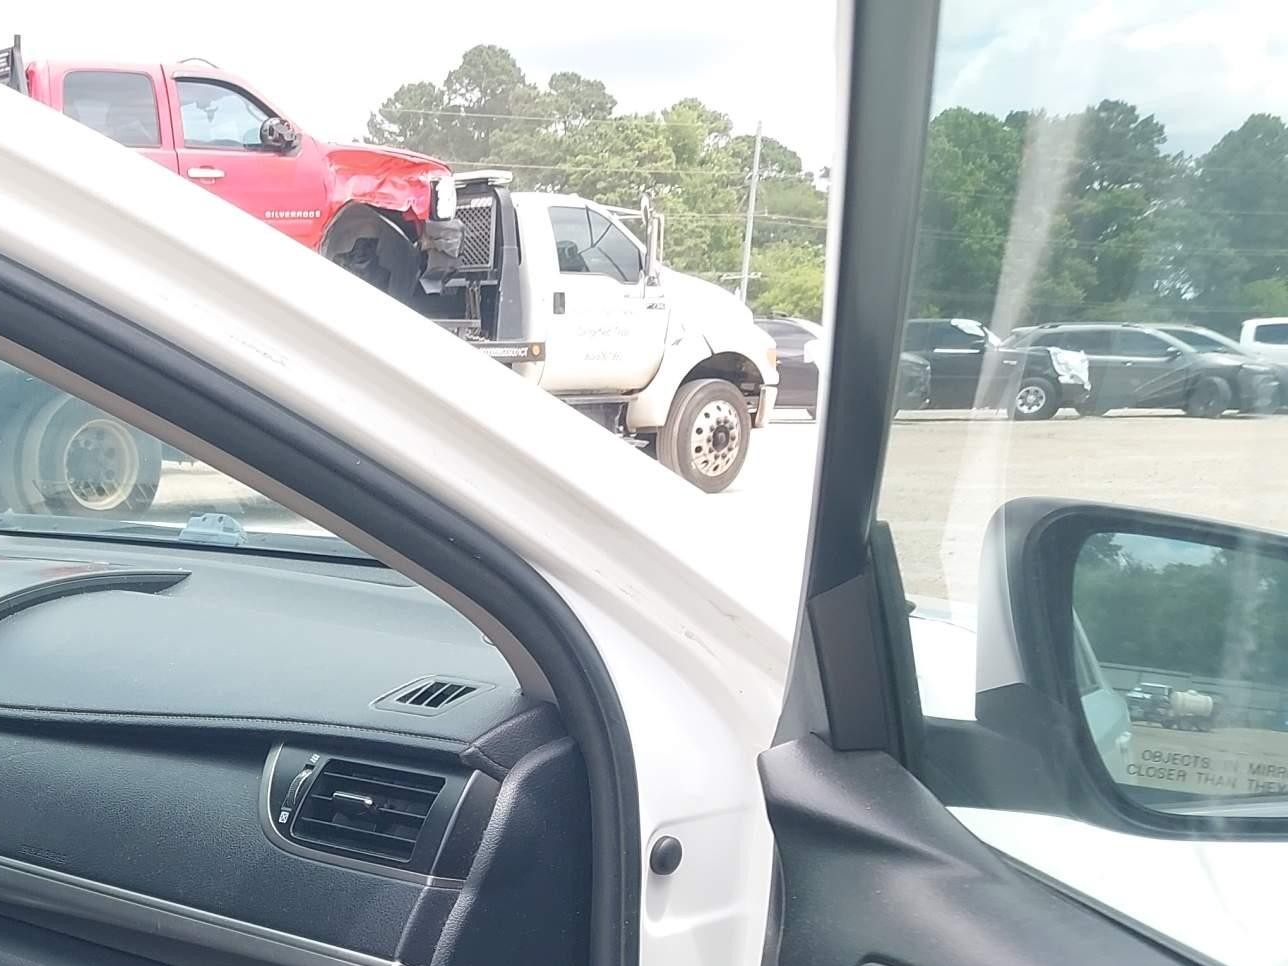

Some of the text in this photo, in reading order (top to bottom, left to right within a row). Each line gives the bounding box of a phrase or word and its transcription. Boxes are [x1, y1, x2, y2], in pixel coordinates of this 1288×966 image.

[1141, 749, 1211, 770] OBJECTS
[1126, 763, 1187, 783] CLOSER
[1196, 771, 1239, 789] THAN
